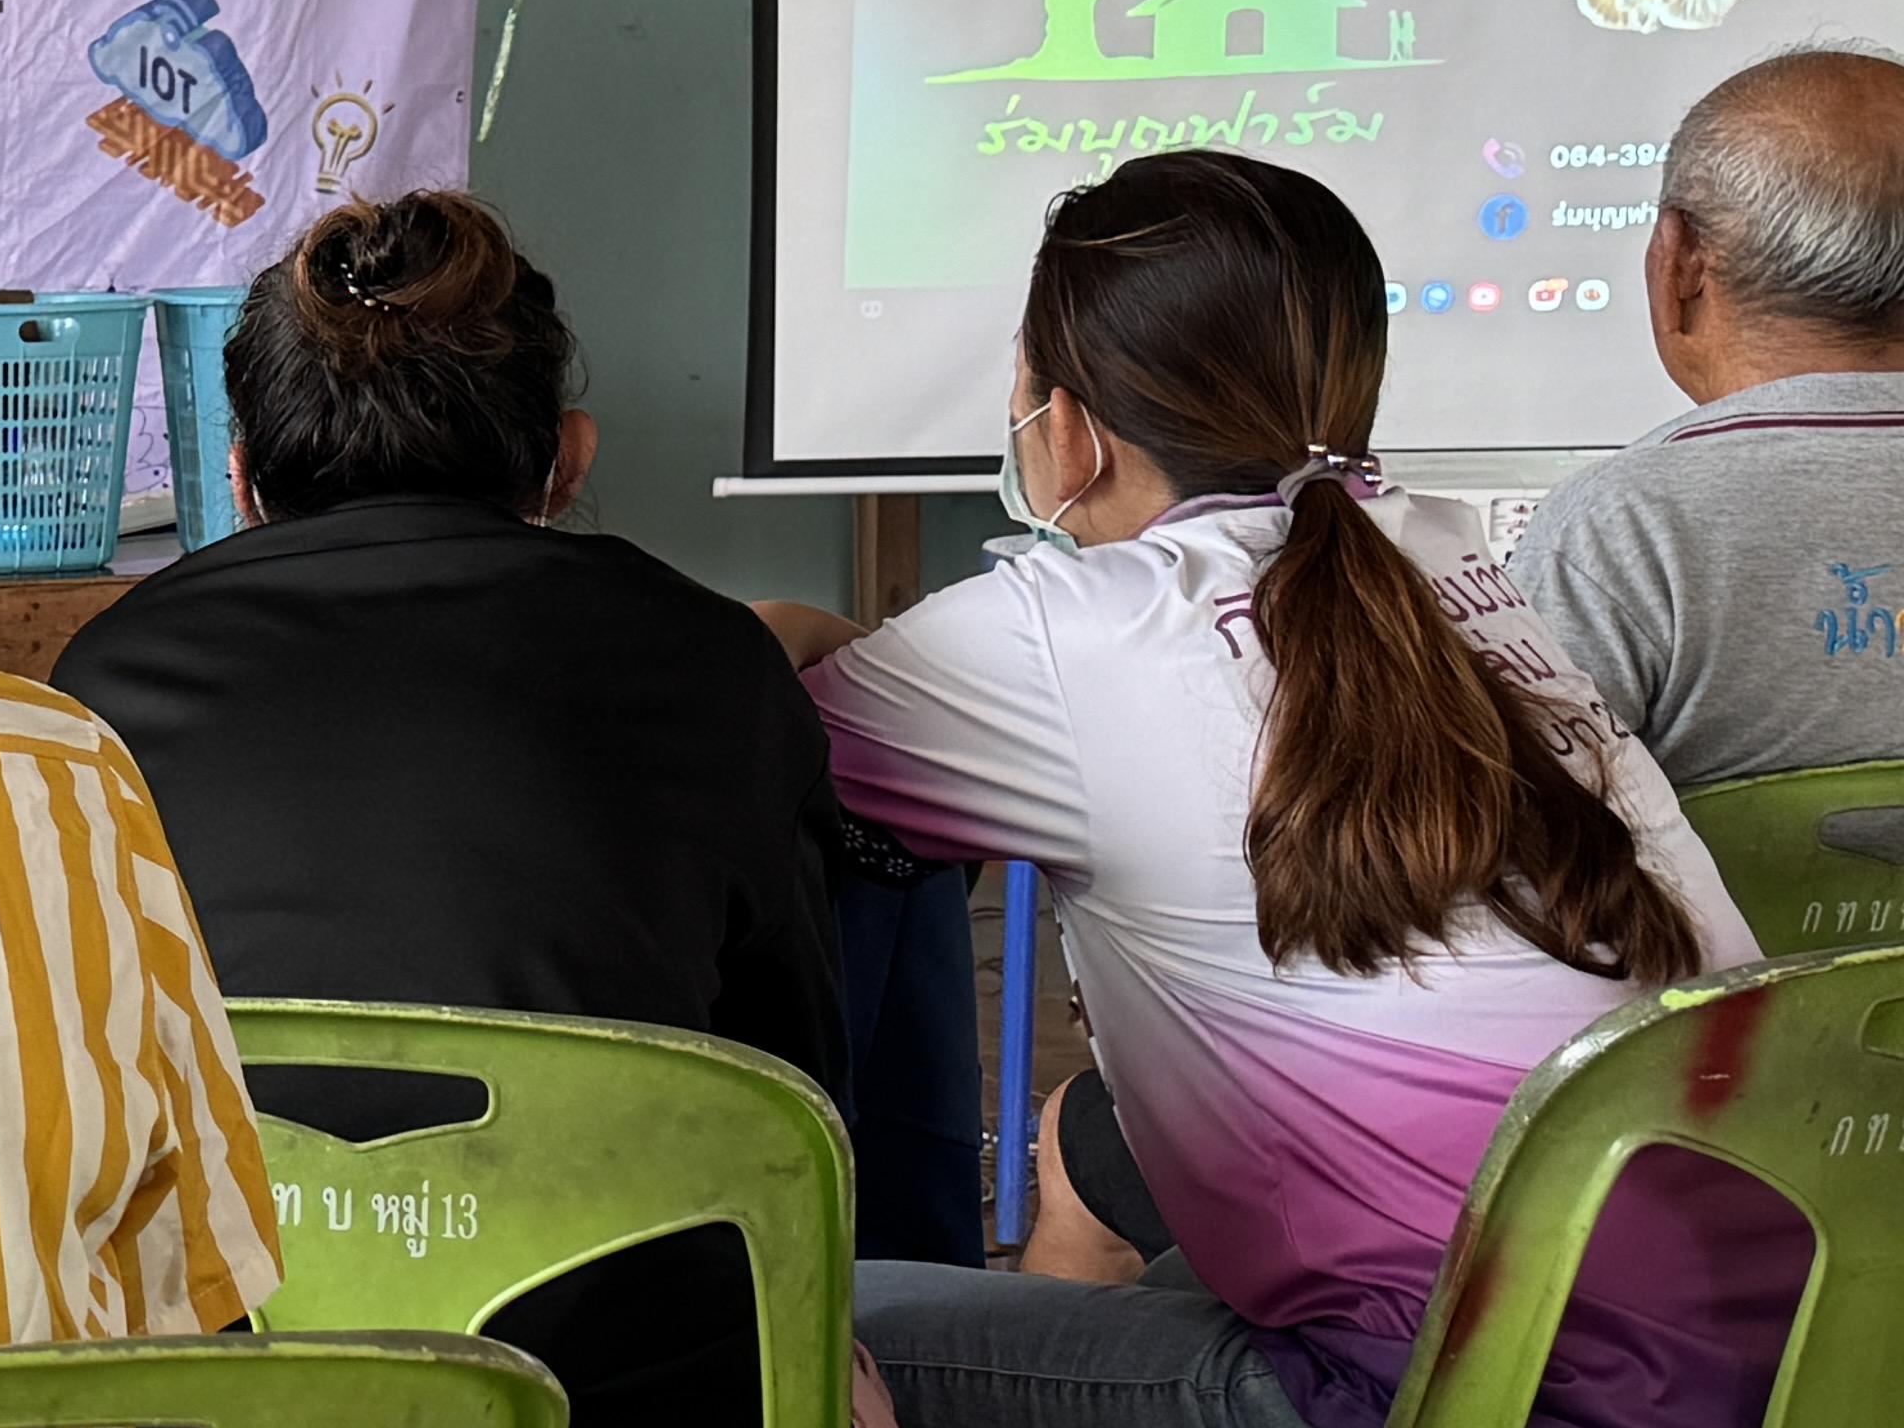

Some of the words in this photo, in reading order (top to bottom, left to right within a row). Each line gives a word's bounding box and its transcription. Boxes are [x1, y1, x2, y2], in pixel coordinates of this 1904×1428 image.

[139, 45, 197, 115] IOT
[1551, 200, 1659, 231] ร่มบุญฟา
[1815, 562, 1904, 659] น้ำ
